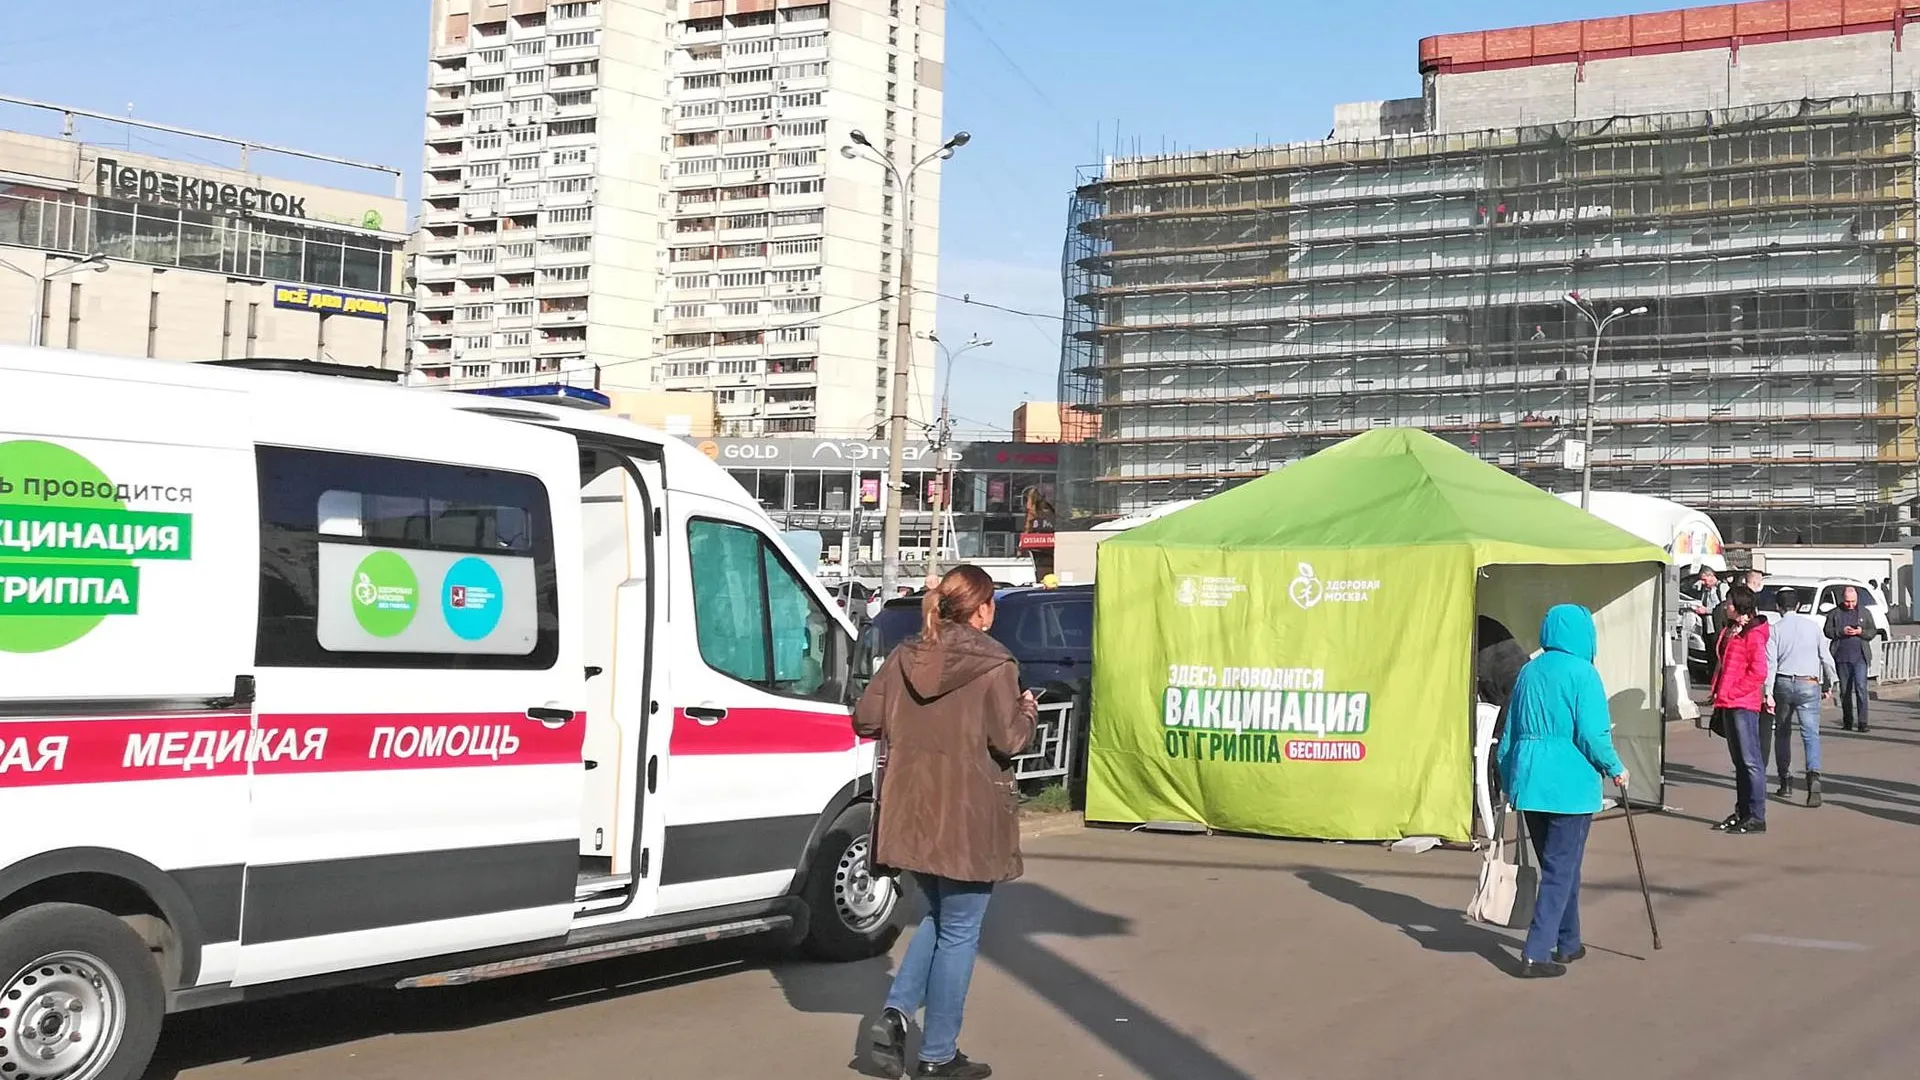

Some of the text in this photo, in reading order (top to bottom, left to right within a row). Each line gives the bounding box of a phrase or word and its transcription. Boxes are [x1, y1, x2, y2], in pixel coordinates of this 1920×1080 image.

[724, 444, 779, 459] GOLD
[24, 477, 192, 502] проводится
[0, 519, 179, 555] ЦИНАЦИЯ
[0, 576, 129, 605] РИППА
[1324, 591, 1369, 602] МОСКВА
[1325, 580, 1381, 590] ЗДОРОВАЯ
[1168, 665, 1324, 690] ЗДЕСЬ ПРОВОДИТСЯ
[1165, 687, 1367, 738] ВАКЦИНАЦИЯ
[369, 725, 519, 761] ПОМОЩЬ
[1166, 730, 1281, 763] ОТ ГРИППА
[1289, 741, 1361, 760] БЕСПЛАТНО
